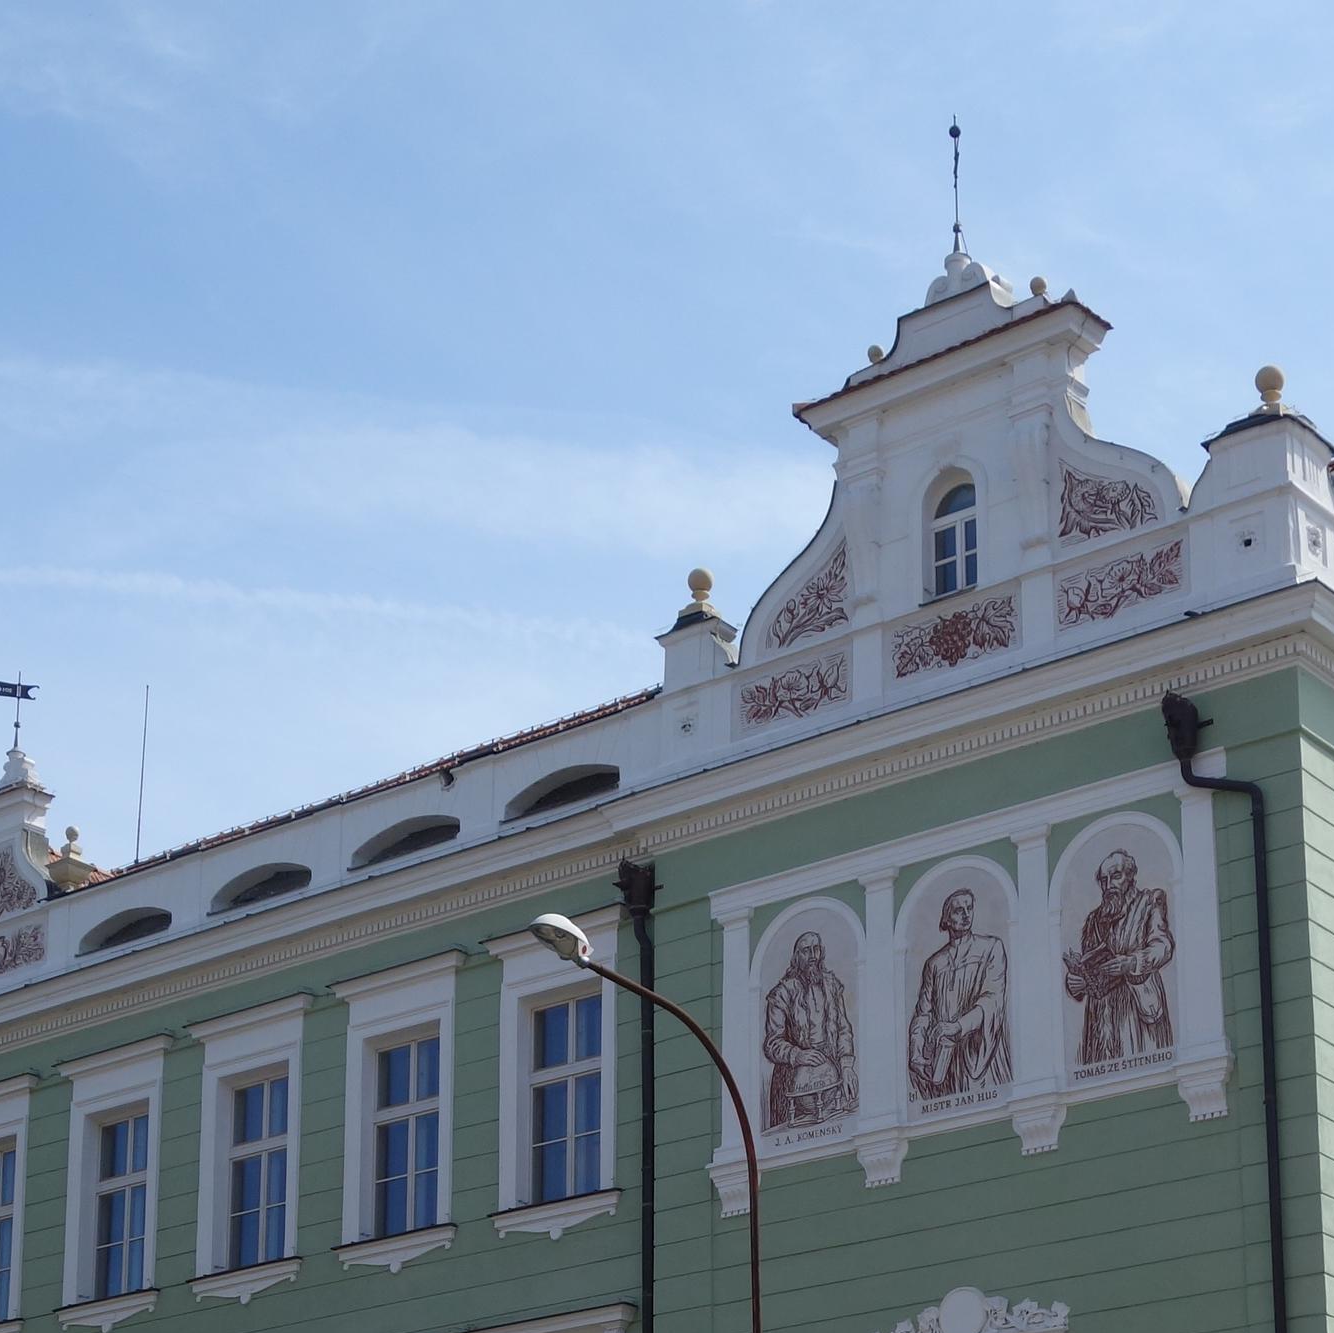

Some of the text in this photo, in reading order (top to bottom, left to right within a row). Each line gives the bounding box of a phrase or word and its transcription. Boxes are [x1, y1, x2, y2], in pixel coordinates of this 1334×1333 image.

[1108, 1062, 1120, 1073] ZE
[921, 1090, 998, 1114] MISTR JAN HUS
[785, 1135, 794, 1145] A.
